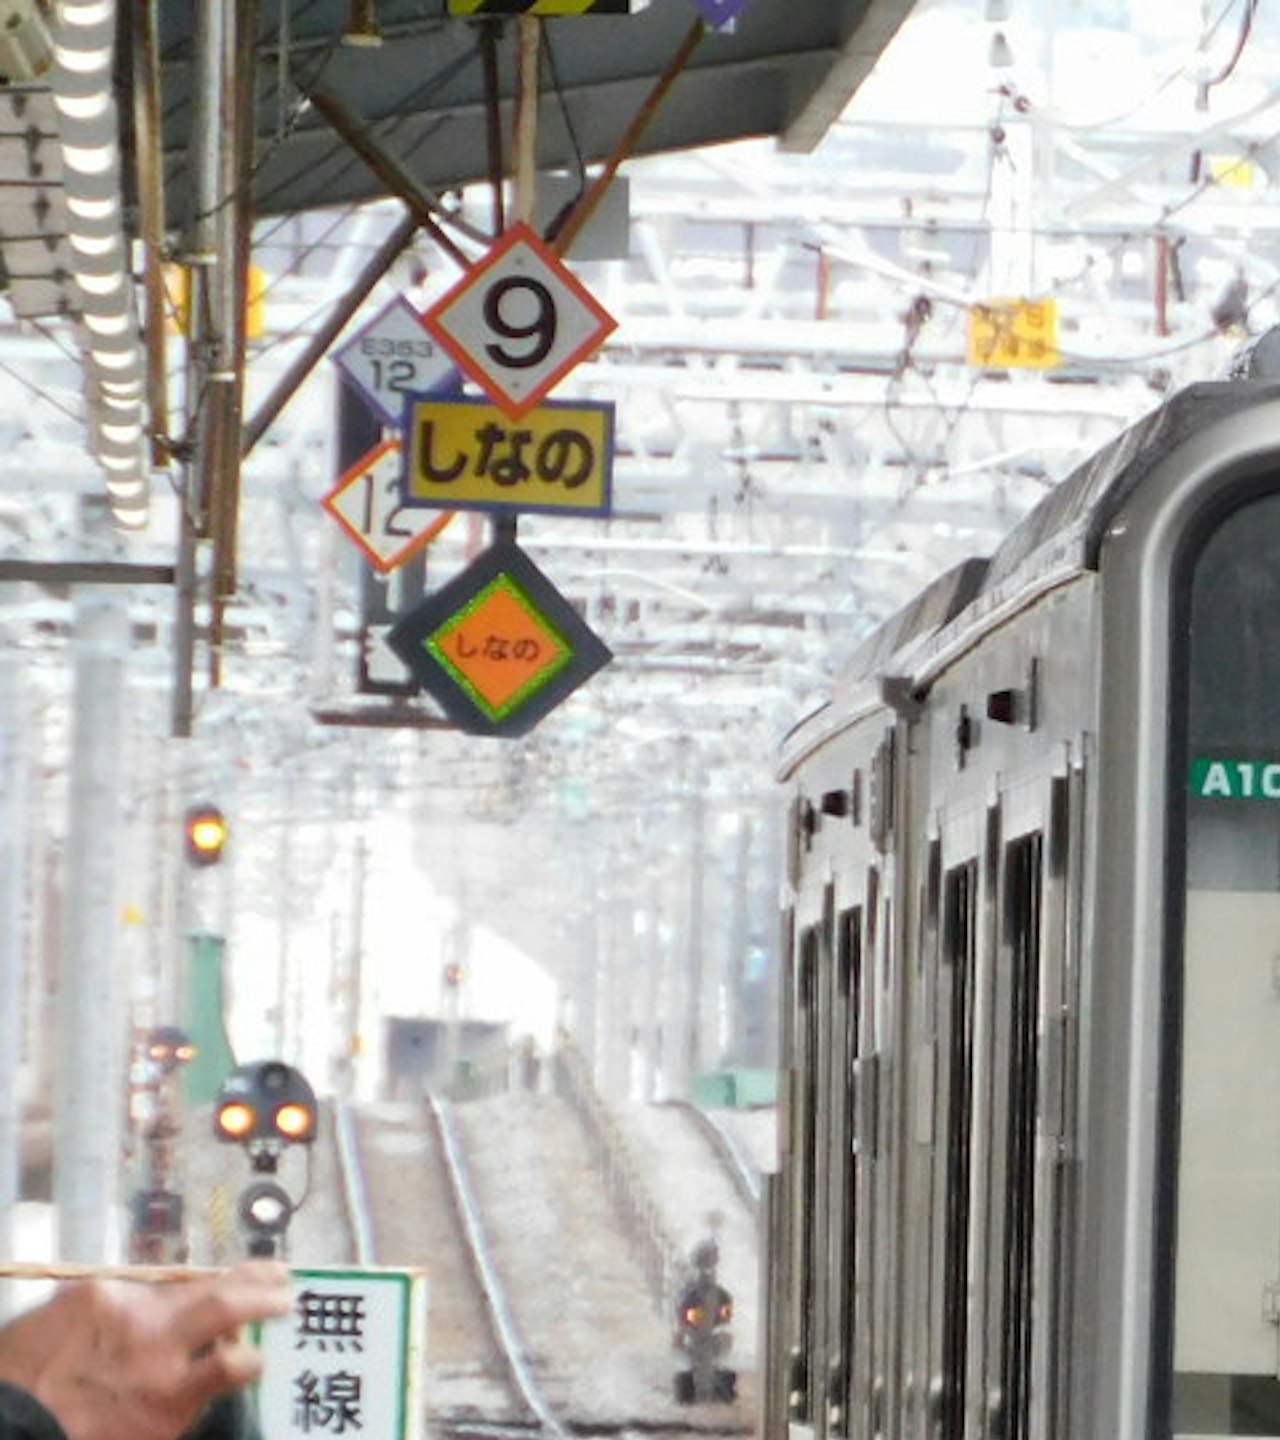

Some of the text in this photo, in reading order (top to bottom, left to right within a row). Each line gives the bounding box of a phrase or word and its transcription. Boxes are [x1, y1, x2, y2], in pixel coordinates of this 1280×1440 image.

[482, 275, 558, 370] 9
[361, 336, 433, 358] E353
[371, 359, 417, 393] 12
[419, 420, 596, 490] しなの
[456, 632, 540, 662] しなの
